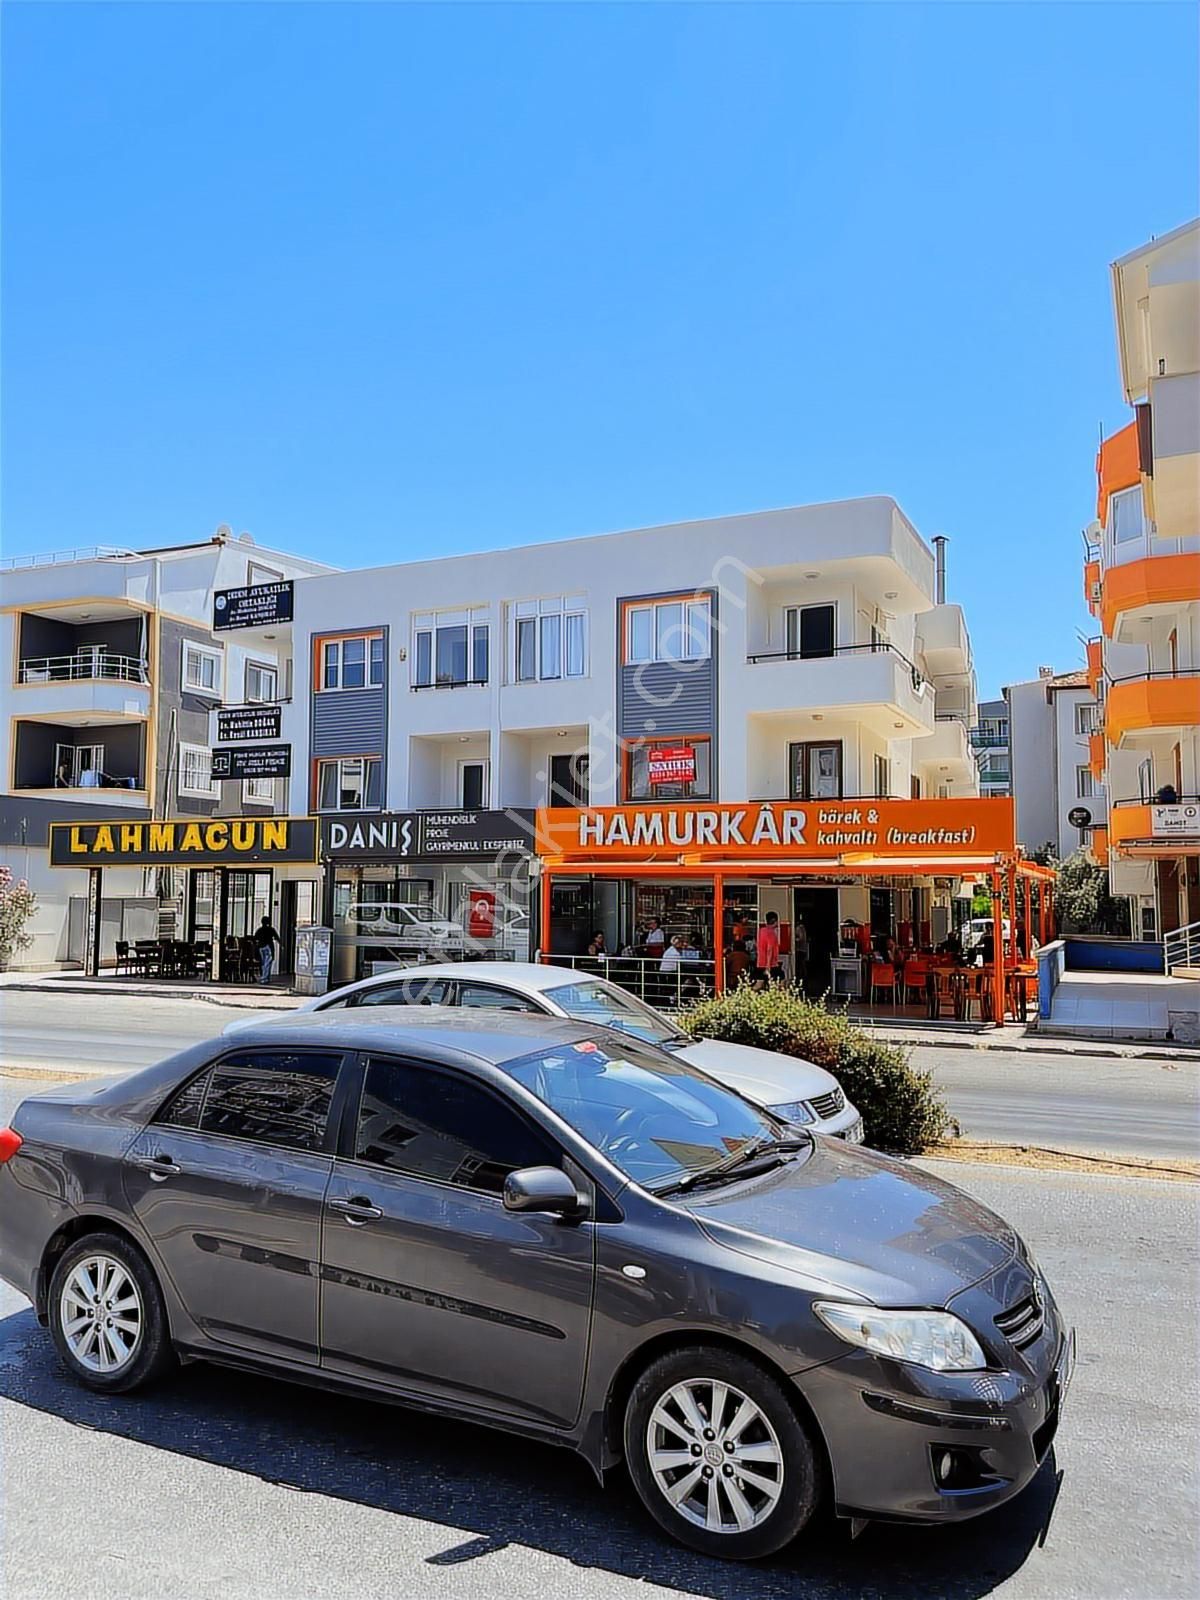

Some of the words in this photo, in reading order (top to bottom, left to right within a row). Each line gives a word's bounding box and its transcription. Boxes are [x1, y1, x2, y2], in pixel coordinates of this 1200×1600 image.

[651, 760, 693, 770] SATILIK
[578, 802, 807, 848] HAMURKÂR
[818, 808, 862, 825] börek
[866, 809, 880, 825] &
[69, 819, 288, 854] LAHMACUN
[329, 819, 412, 857] DANIŞ
[817, 829, 878, 846] kahvaltı
[886, 825, 976, 846] (breakfast)
